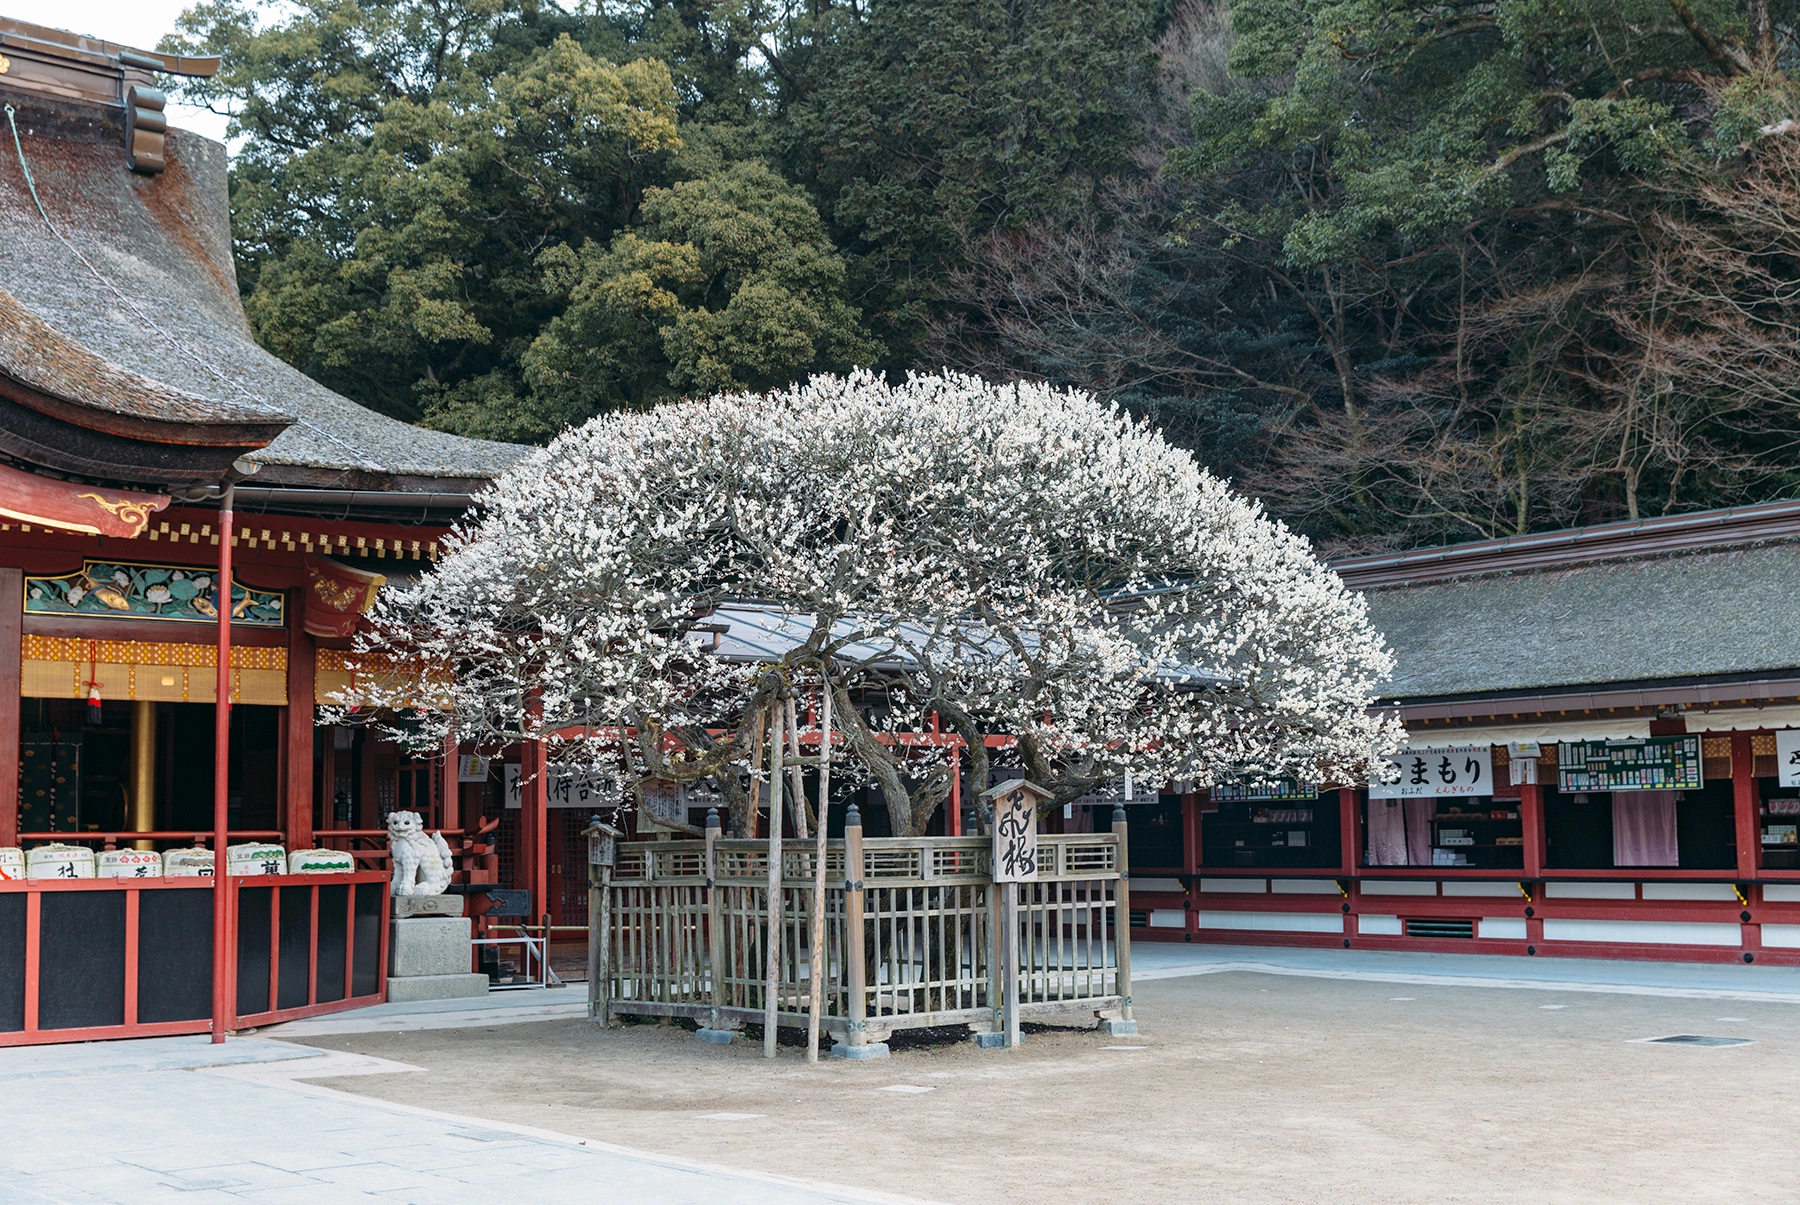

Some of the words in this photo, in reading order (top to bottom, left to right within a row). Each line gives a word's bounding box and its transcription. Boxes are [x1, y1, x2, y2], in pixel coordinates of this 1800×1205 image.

[1401, 787, 1423, 795] おふだ
[1435, 786, 1474, 794] えんぎもの
